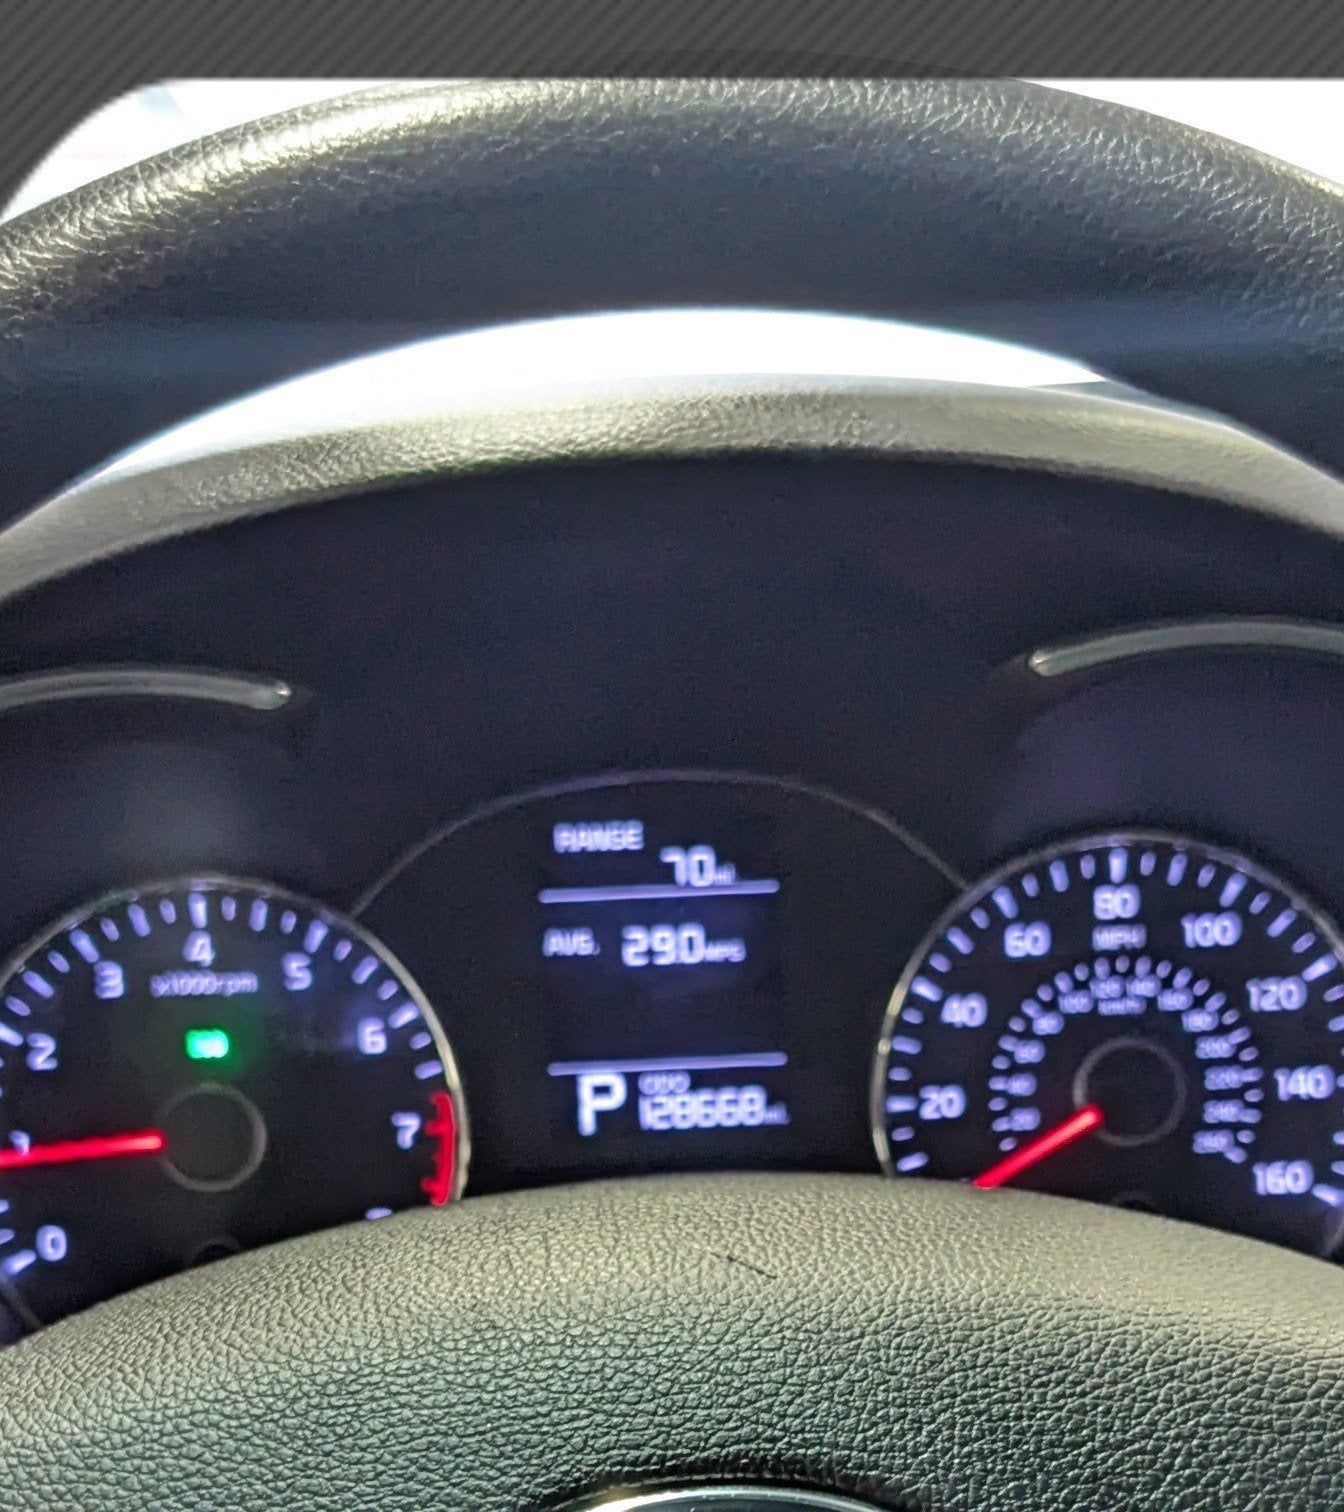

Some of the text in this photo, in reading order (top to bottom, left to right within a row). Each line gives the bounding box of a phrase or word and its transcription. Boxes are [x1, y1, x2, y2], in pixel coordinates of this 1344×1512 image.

[554, 820, 644, 853] RANGE
[1093, 883, 1141, 919] 80
[1003, 920, 1051, 958] 60
[1181, 911, 1243, 948] 100
[183, 930, 215, 967] 4
[95, 963, 126, 998] 3
[282, 953, 313, 992] 5
[941, 993, 988, 1028] 40
[1246, 975, 1308, 1012] 120
[28, 1034, 58, 1071] 2
[357, 1018, 387, 1055] 6
[1273, 1064, 1335, 1100] 140
[577, 1072, 626, 1136] P
[918, 1085, 967, 1121] 20
[392, 1113, 422, 1149] 7
[1253, 1160, 1315, 1195] 160
[37, 1225, 68, 1262] 0
